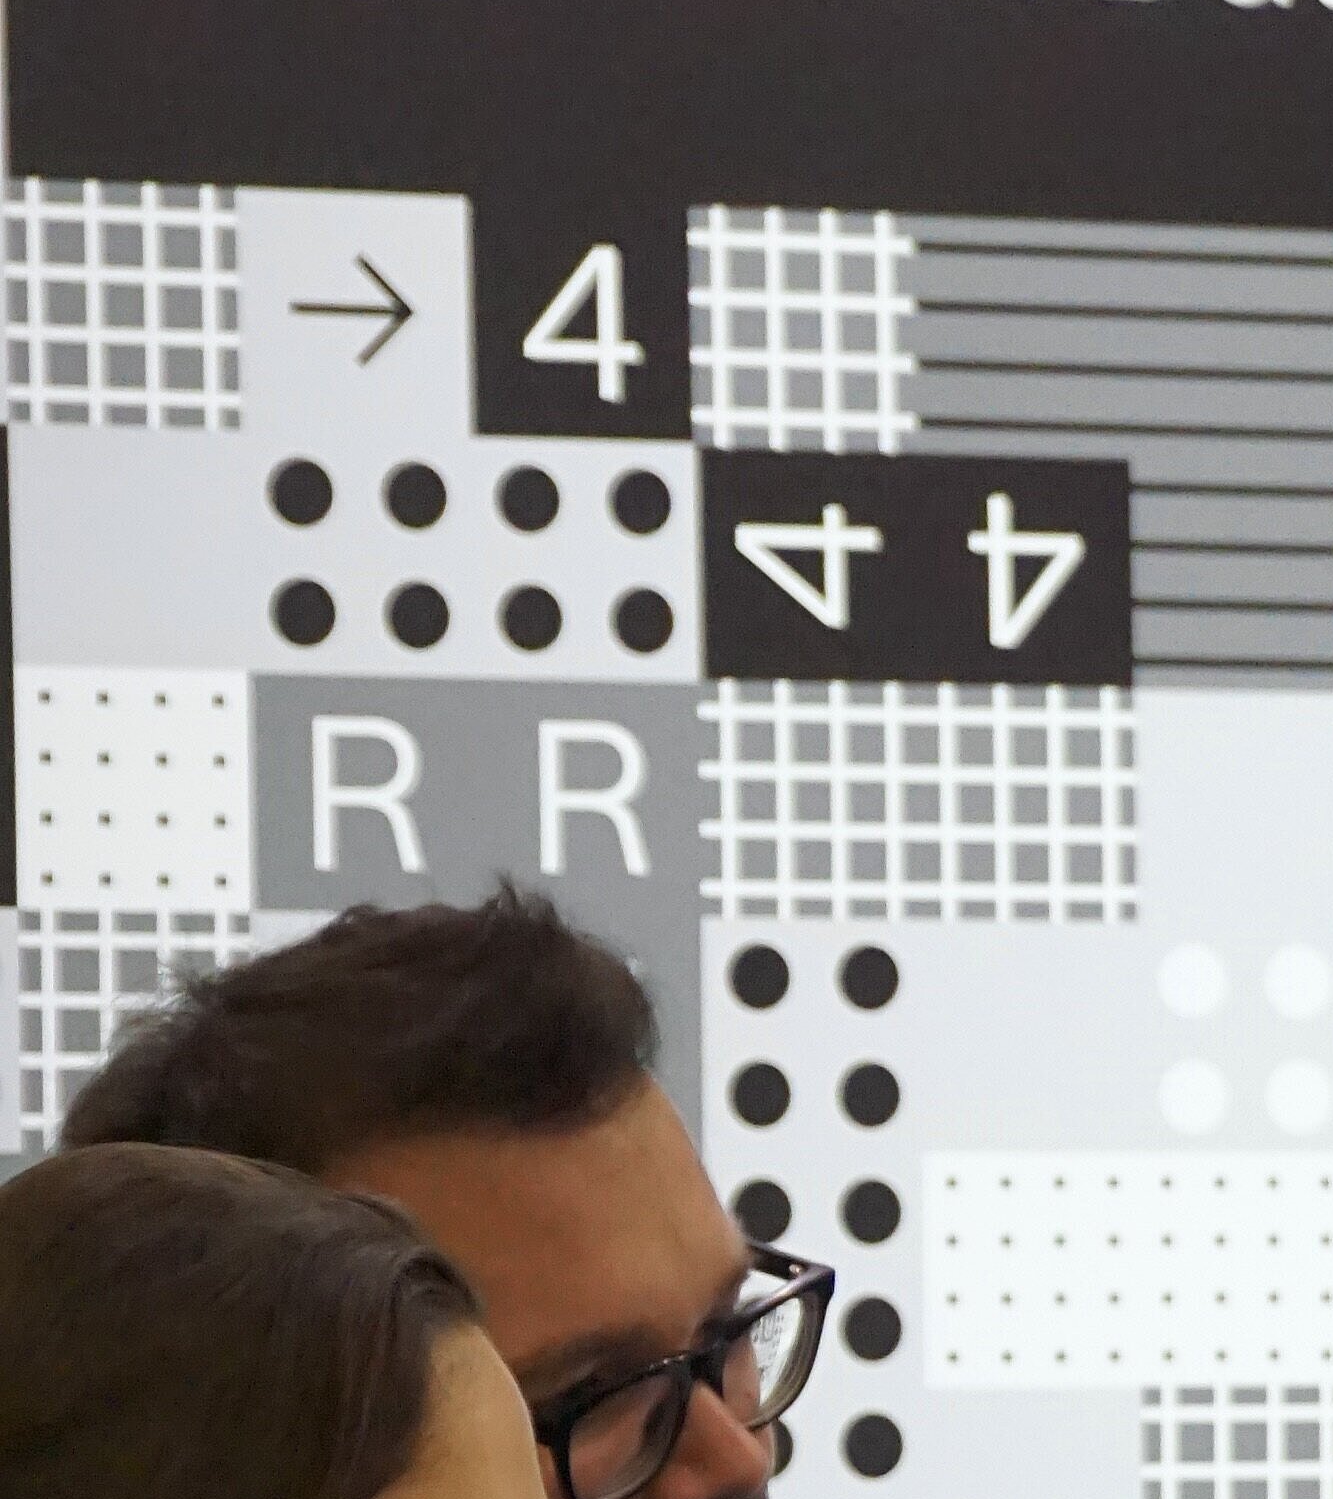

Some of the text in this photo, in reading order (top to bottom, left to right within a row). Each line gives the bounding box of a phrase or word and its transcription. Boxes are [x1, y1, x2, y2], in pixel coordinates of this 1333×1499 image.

[522, 243, 645, 402] 4
[734, 491, 1087, 649] 4 4
[311, 713, 651, 878] R R
